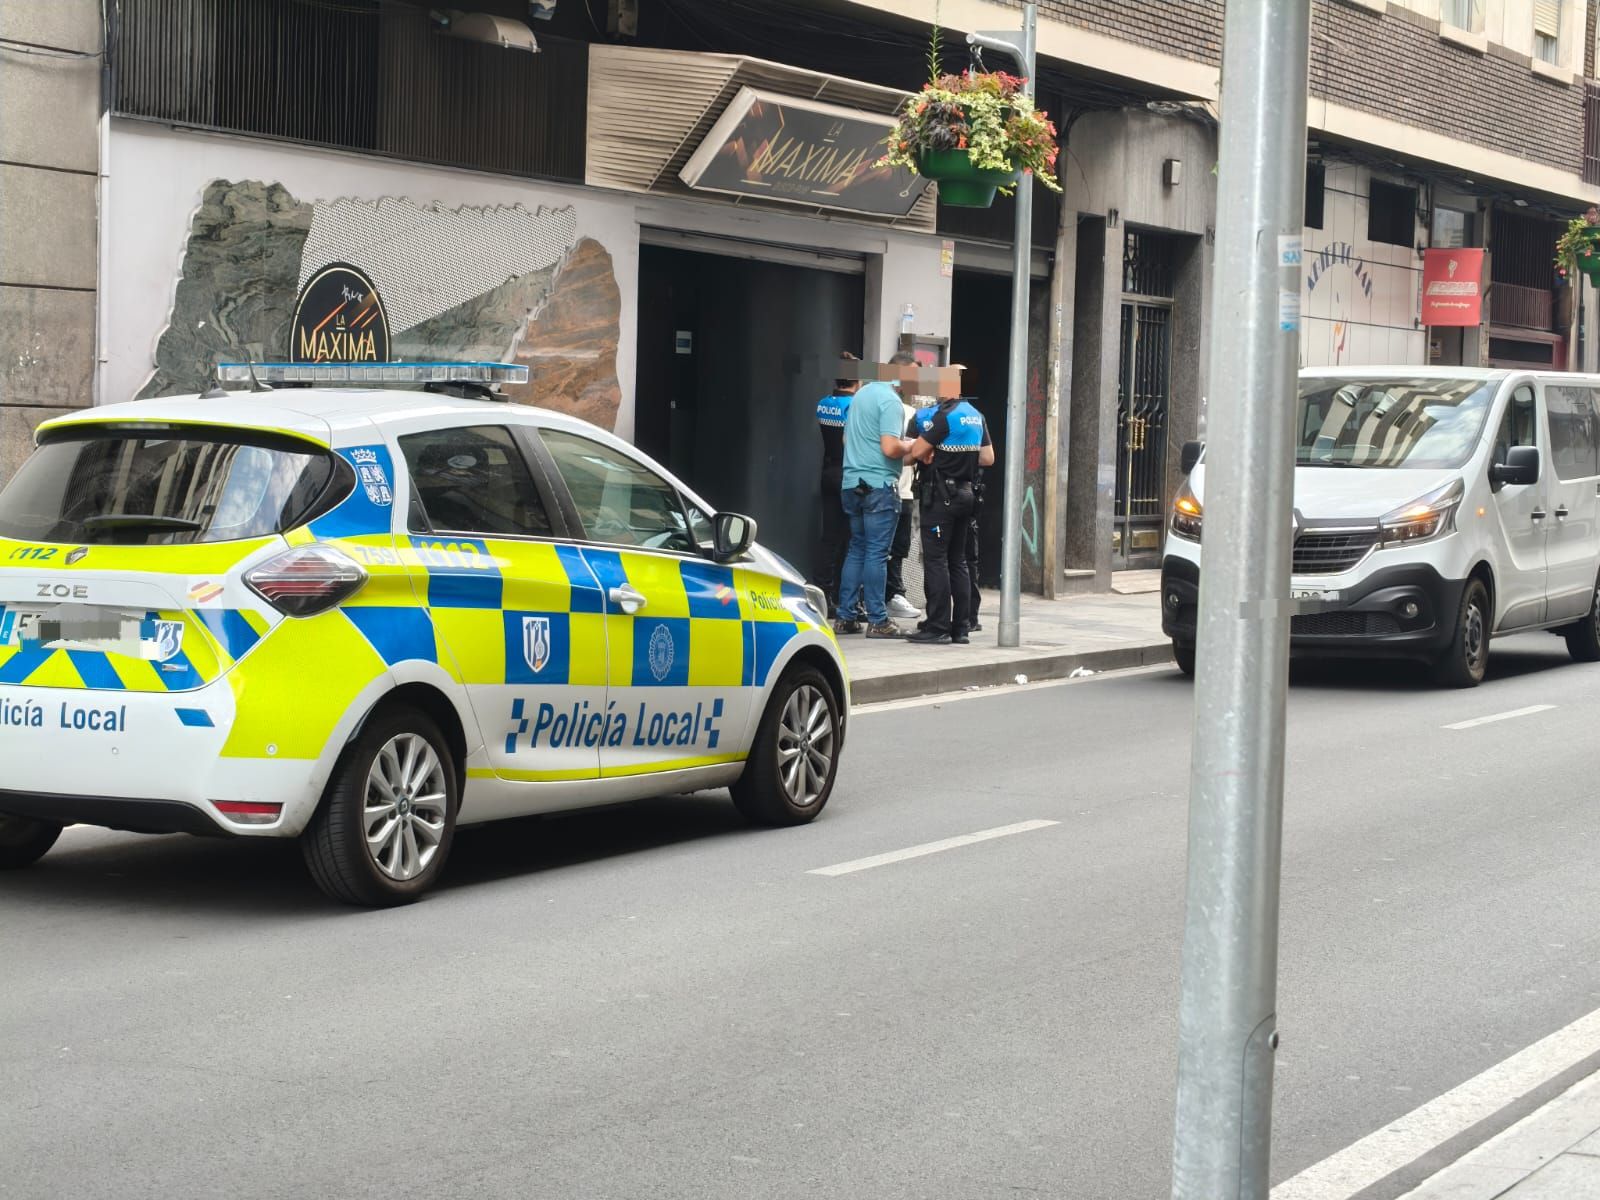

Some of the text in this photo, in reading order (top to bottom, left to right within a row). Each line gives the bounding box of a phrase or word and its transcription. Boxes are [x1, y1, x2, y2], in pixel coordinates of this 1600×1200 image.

[750, 128, 867, 186] MAXIMA
[336, 314, 346, 326] LA
[300, 325, 377, 361] MAXIMA
[354, 547, 397, 564] 759
[36, 583, 89, 599] ZOE
[60, 702, 126, 732] Local
[531, 700, 702, 749] Policía Local
